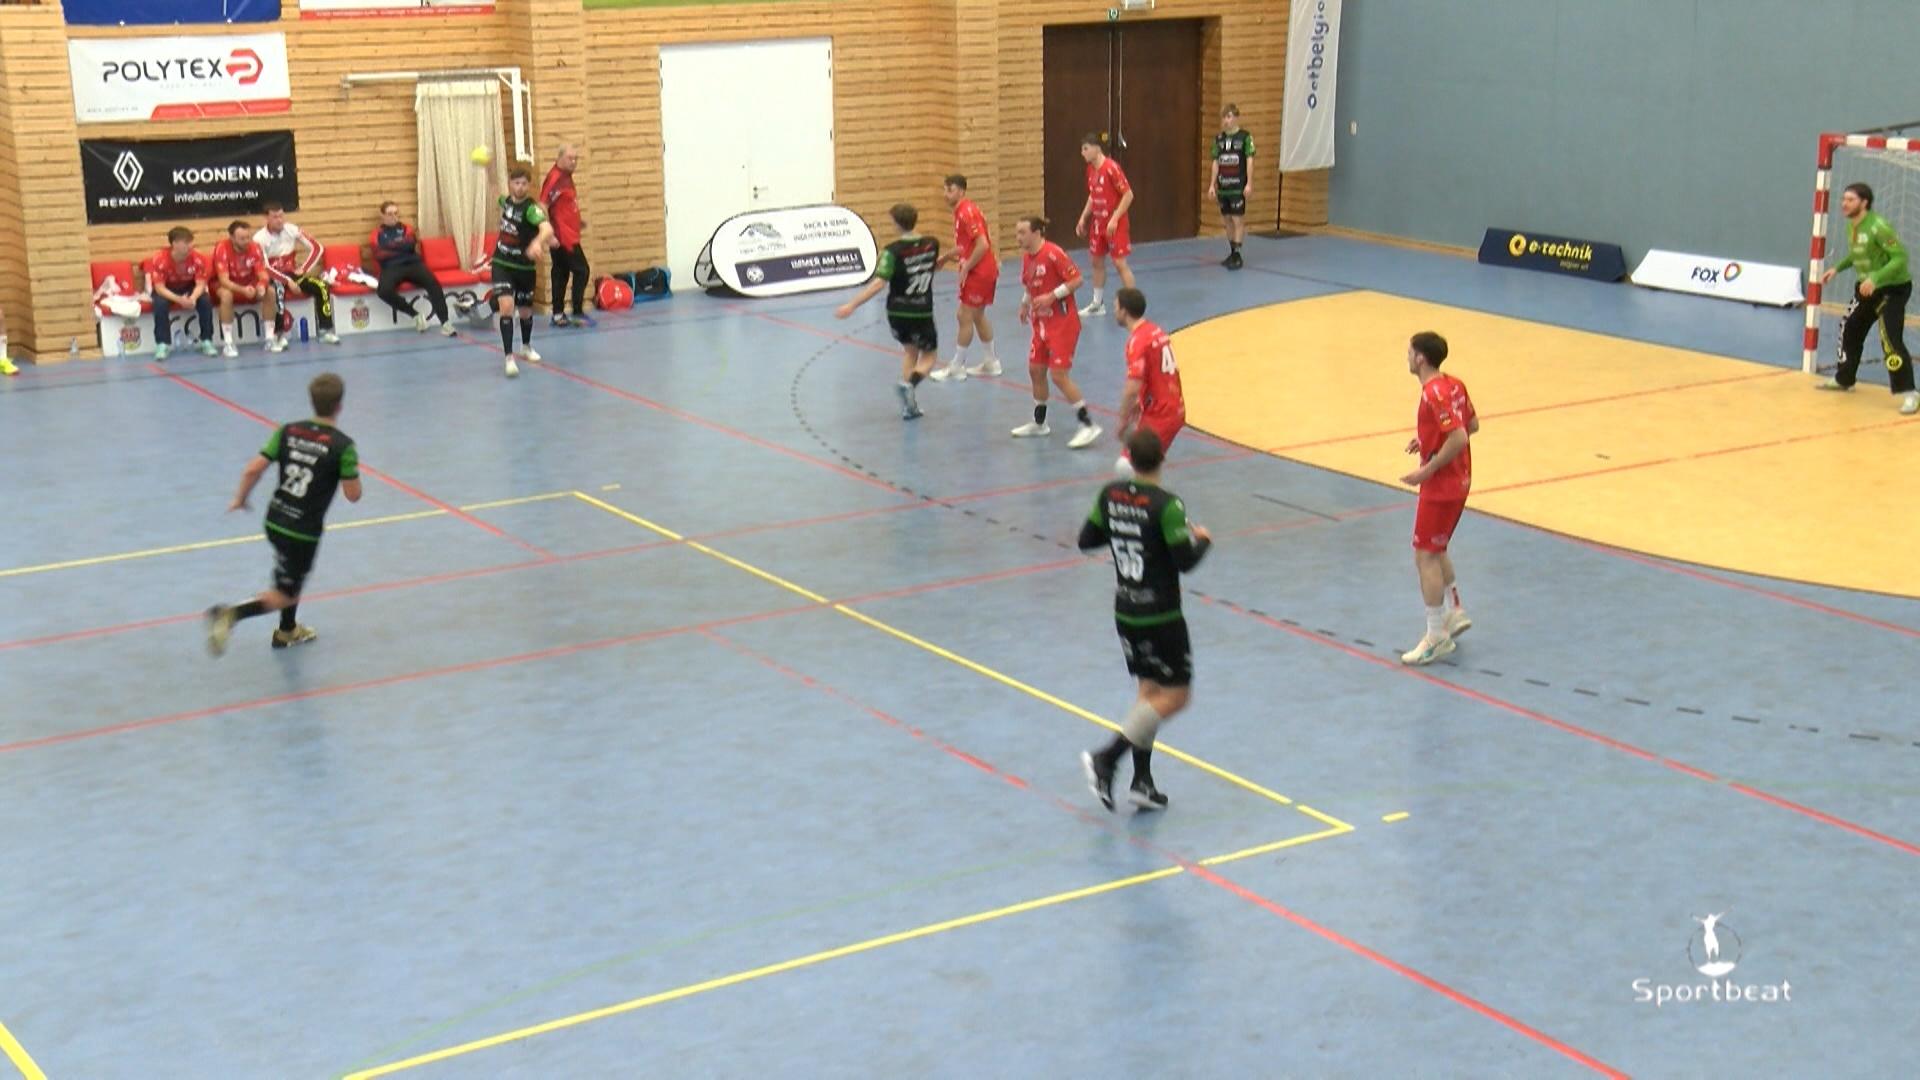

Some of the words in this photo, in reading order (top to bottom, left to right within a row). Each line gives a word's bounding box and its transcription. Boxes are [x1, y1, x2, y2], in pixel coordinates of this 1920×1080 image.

[102, 58, 223, 83] POLYTEX
[172, 166, 252, 185] KOONEN
[255, 164, 274, 180] N.
[98, 195, 165, 209] RENAULT
[174, 190, 259, 204] info@koonen.eu
[1528, 240, 1593, 261] e-technik
[790, 256, 820, 269] IMMER
[821, 255, 836, 265] AM
[1691, 266, 1720, 283] FOX
[281, 462, 314, 498] 23
